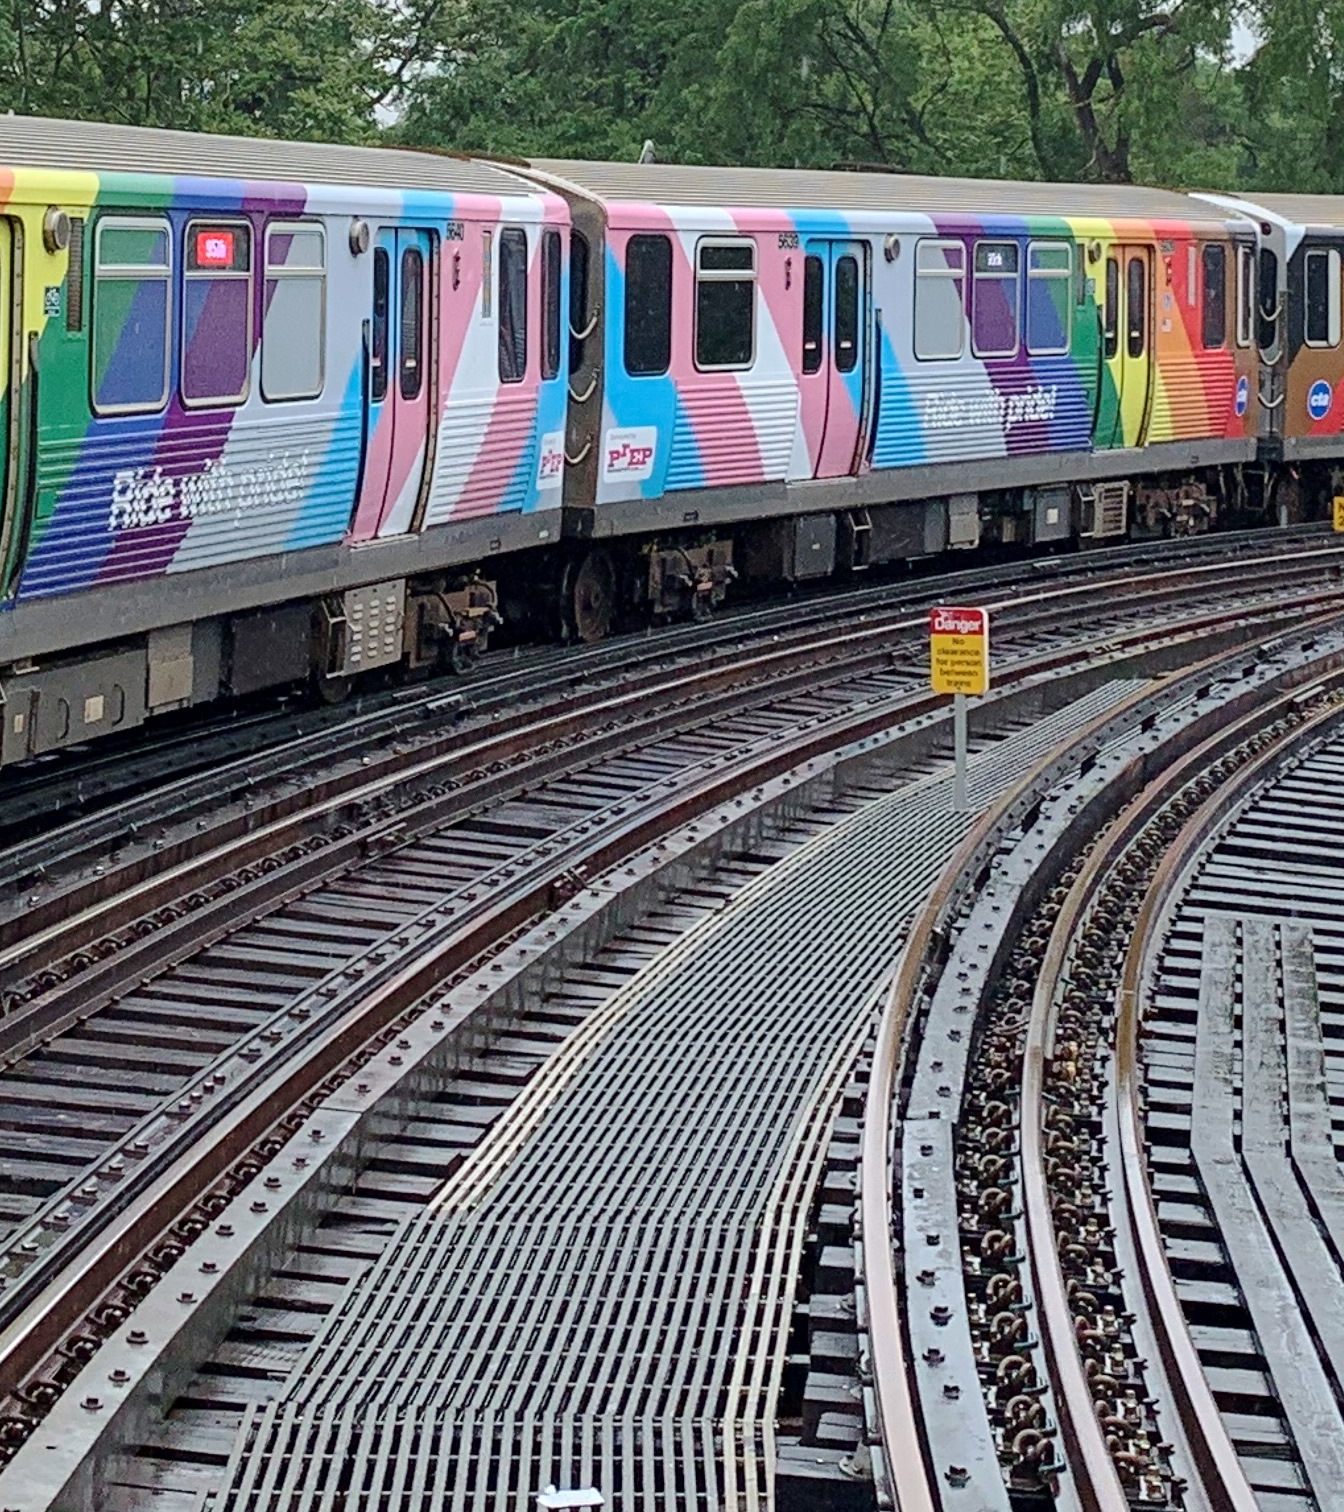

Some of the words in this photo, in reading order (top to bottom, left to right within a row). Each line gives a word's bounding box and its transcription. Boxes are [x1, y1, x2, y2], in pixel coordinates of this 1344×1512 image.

[1004, 385, 1057, 431] pride!
[107, 465, 175, 531] Ride
[180, 457, 233, 520] with
[935, 617, 982, 634] Danger
